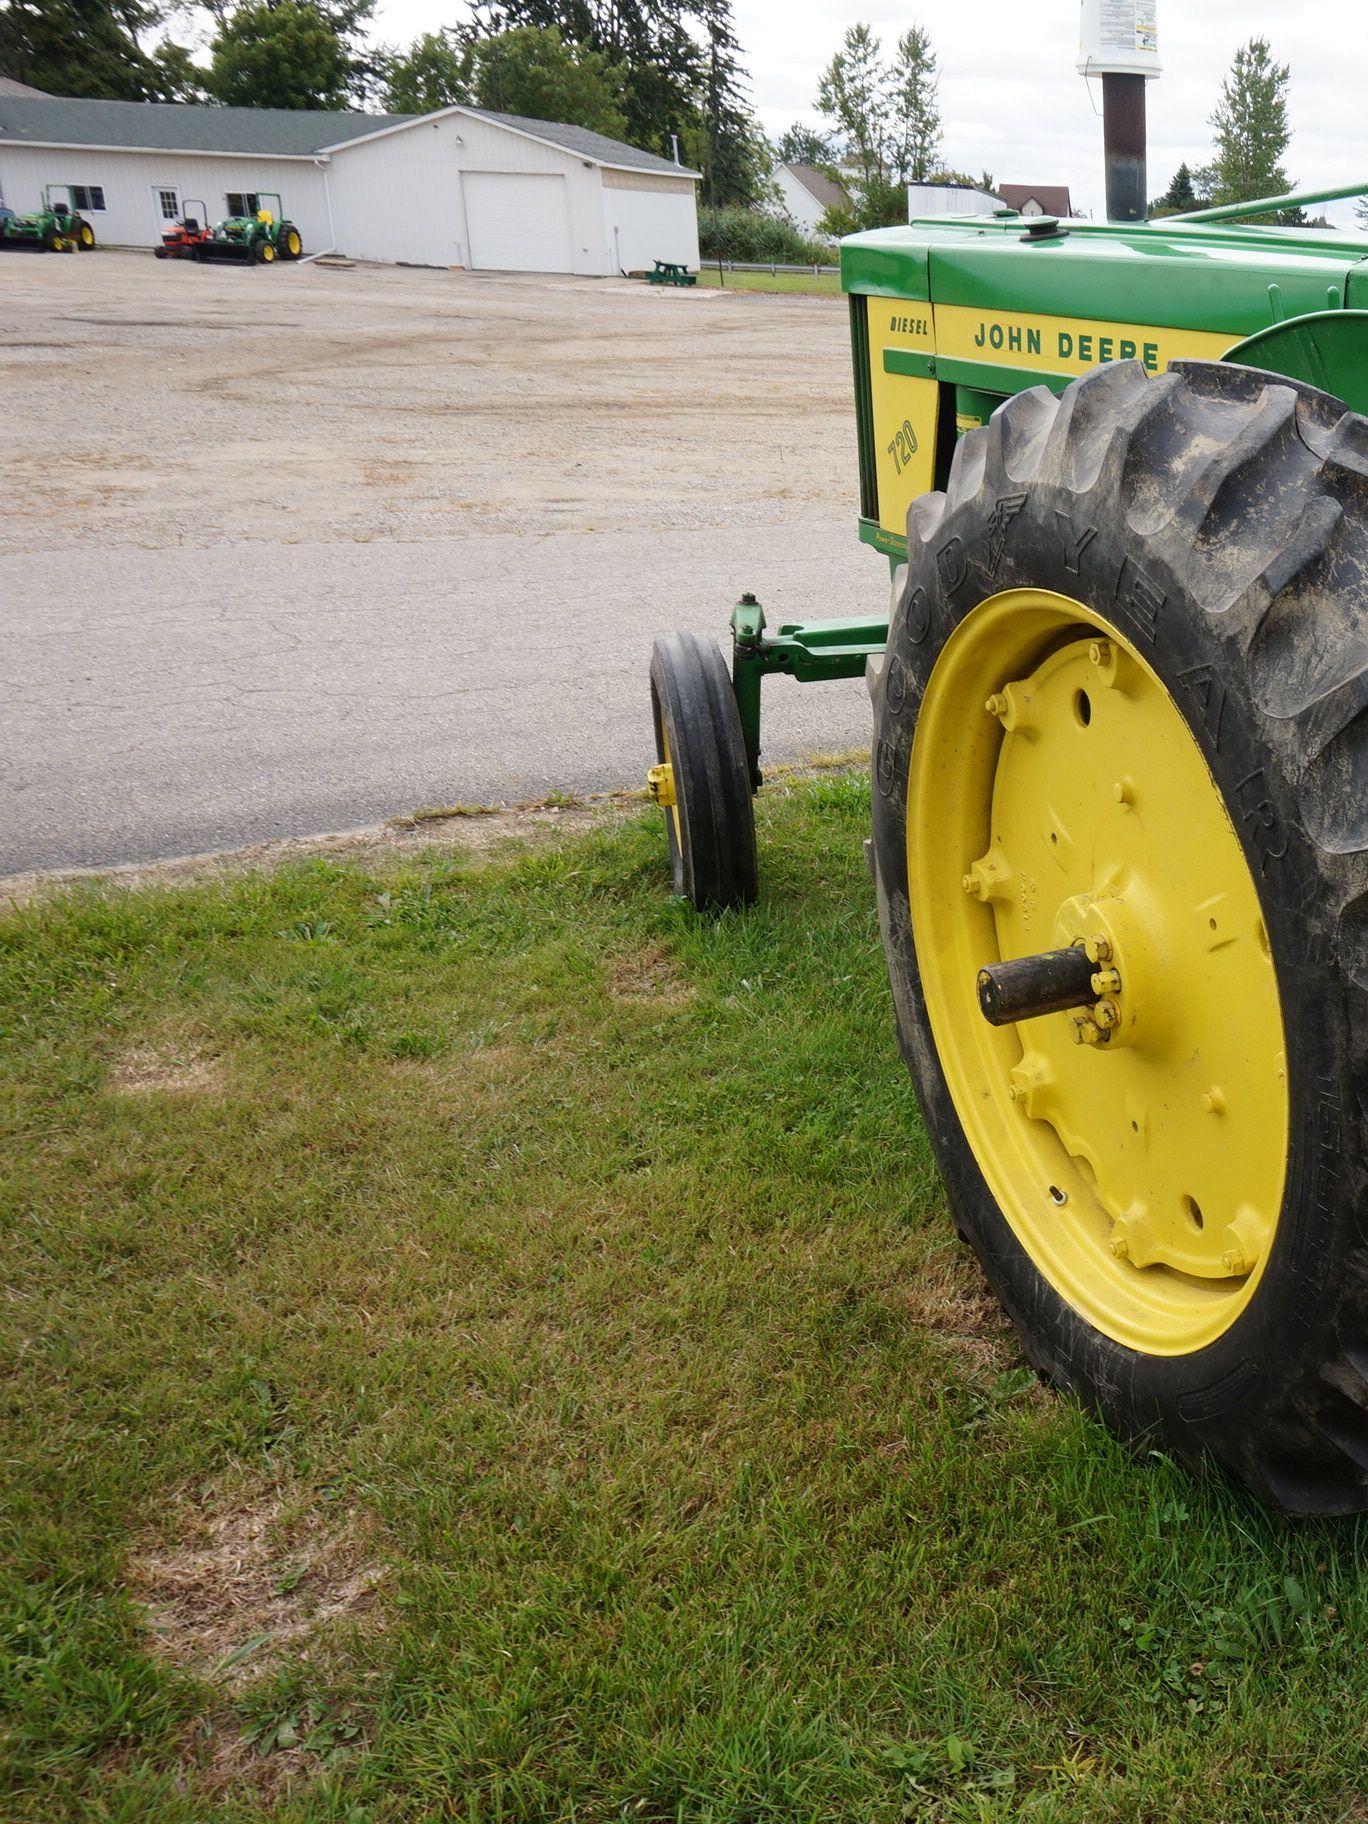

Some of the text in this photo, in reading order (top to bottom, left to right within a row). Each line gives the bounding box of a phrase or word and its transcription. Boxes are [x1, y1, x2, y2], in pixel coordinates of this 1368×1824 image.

[890, 316, 928, 335] DIESEL
[974, 323, 1158, 371] JOHN DEERE
[887, 419, 918, 475] 720
